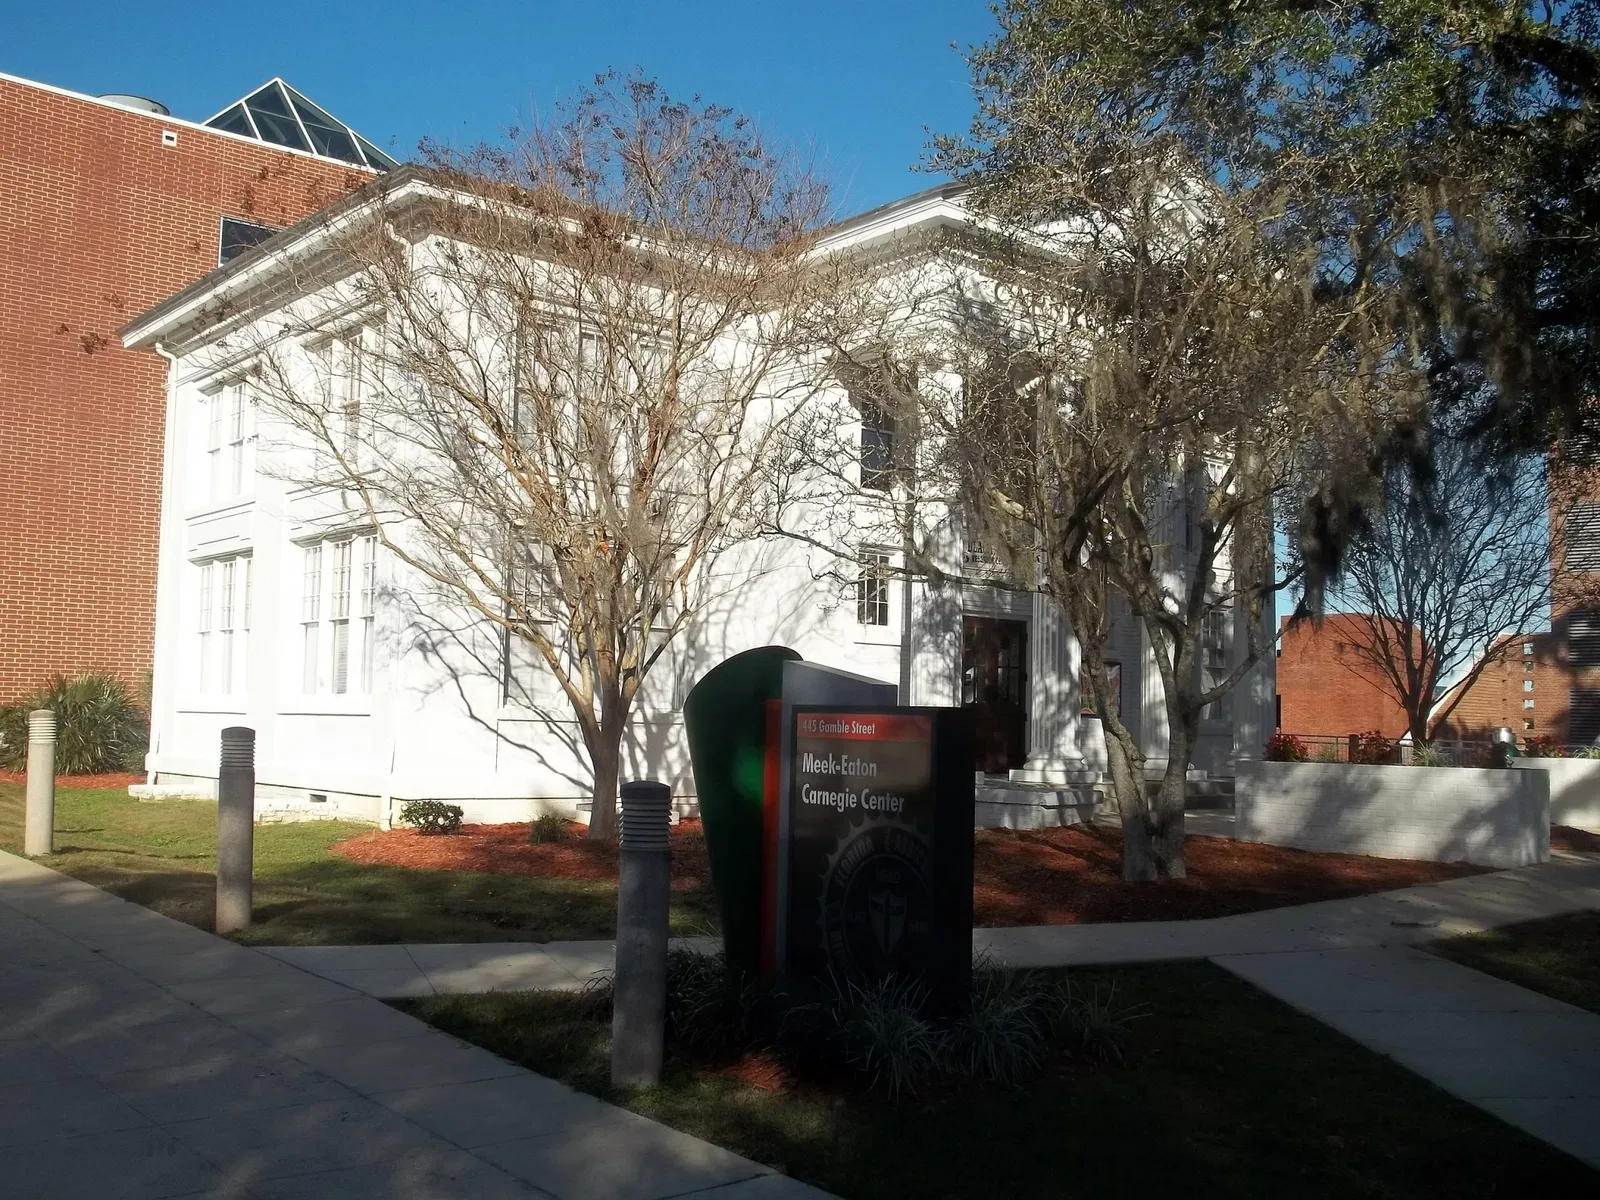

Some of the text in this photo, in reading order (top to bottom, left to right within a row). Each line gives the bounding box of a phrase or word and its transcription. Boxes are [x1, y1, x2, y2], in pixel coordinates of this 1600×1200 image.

[802, 719, 876, 735] 445 Gamble Street
[802, 752, 877, 777] Meek-Eaton
[801, 783, 905, 813] Carnegie Center
